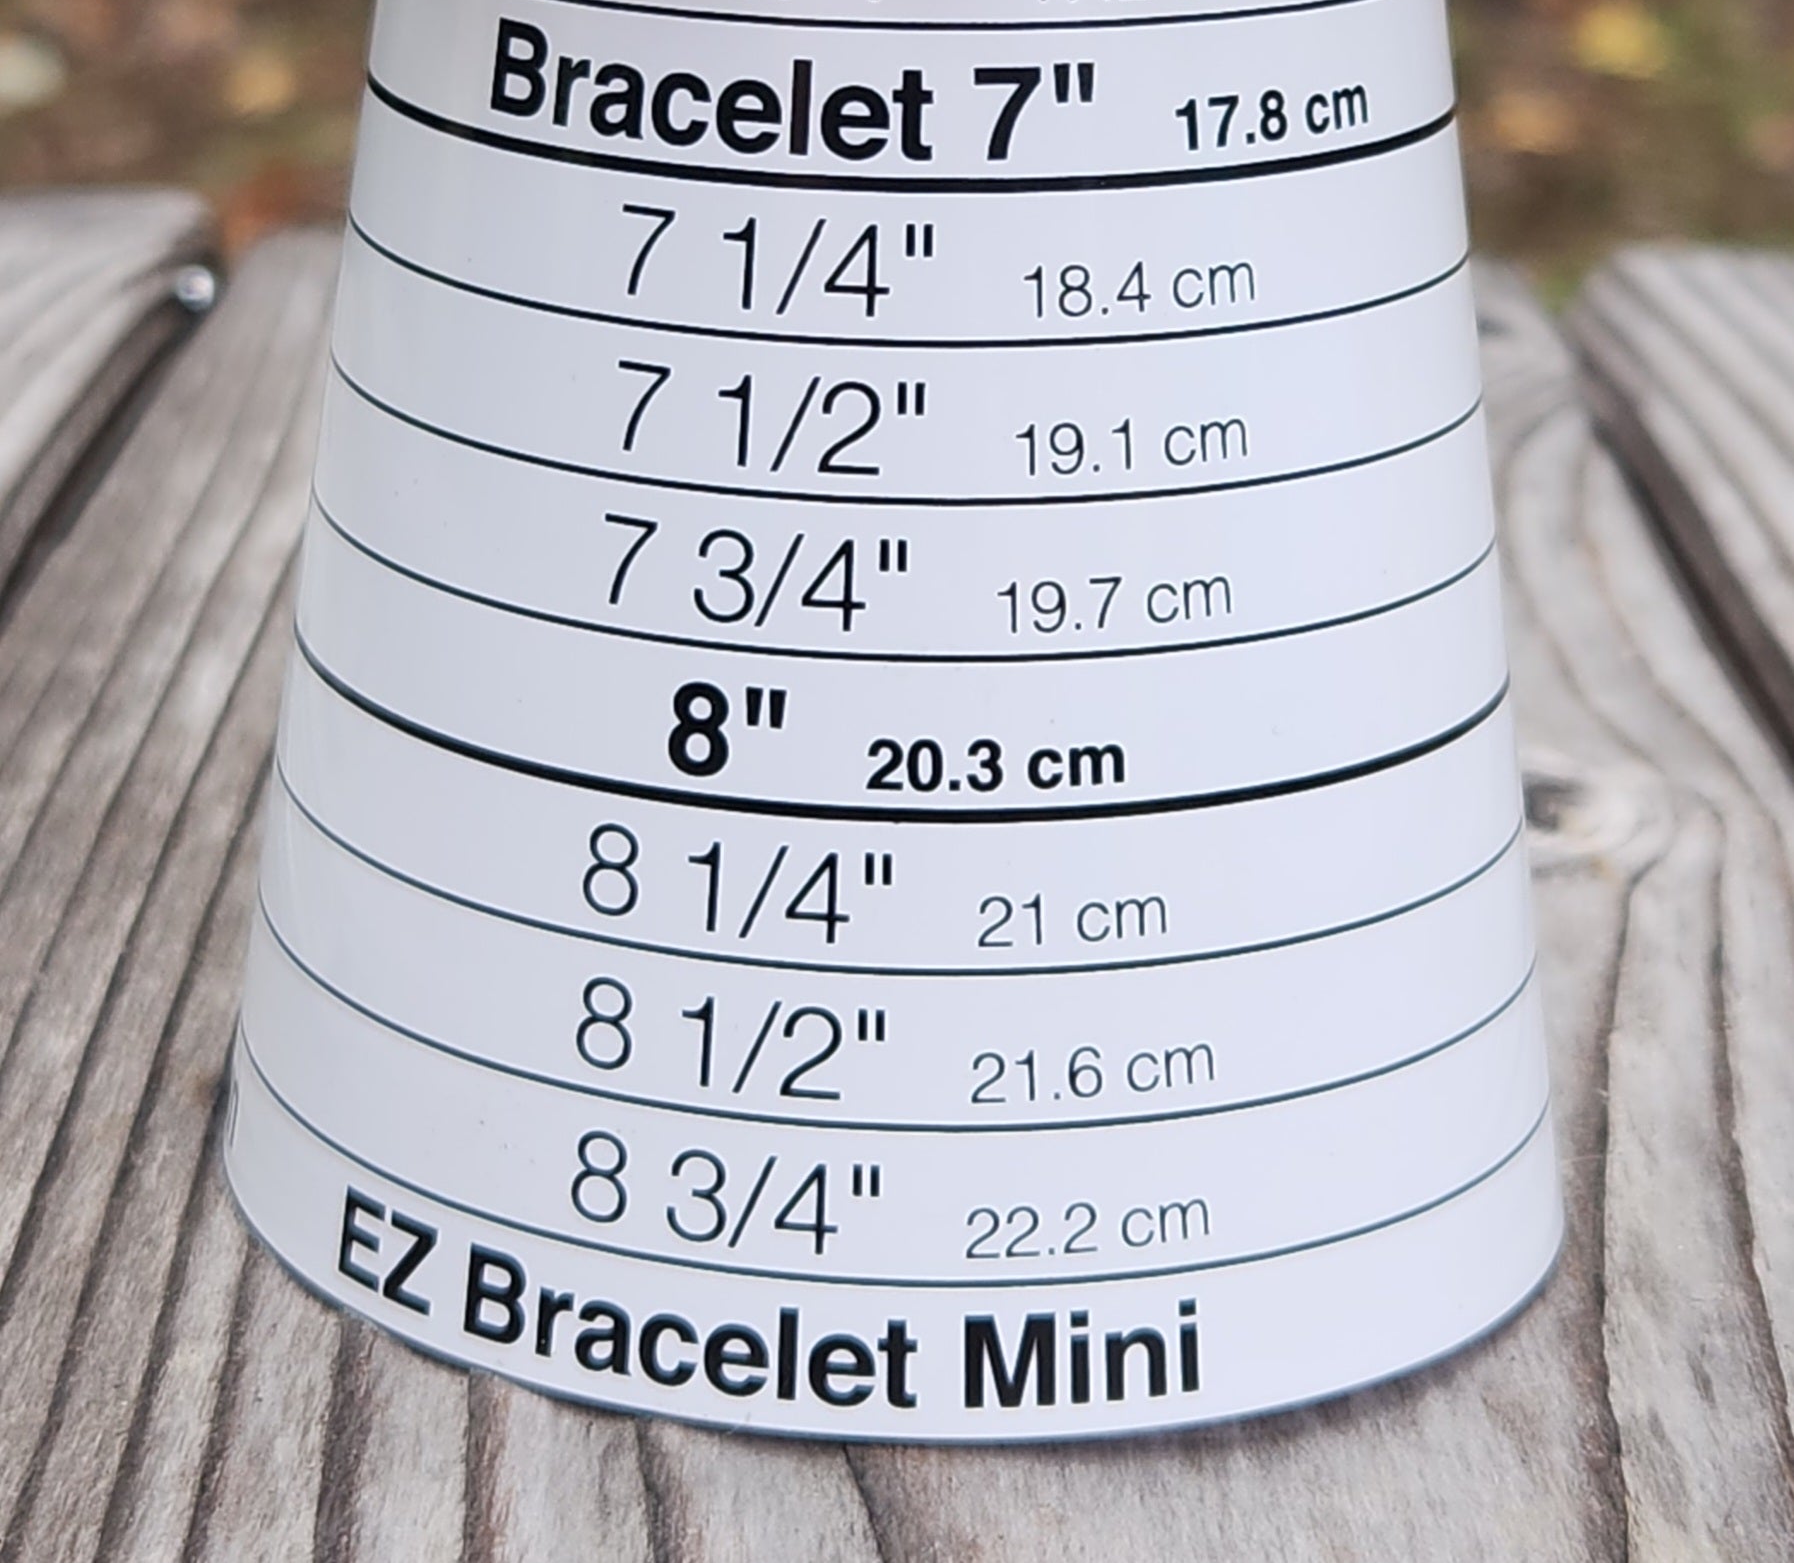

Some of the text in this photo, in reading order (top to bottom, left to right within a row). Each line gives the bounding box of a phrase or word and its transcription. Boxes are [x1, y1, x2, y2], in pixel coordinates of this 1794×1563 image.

[490, 18, 1369, 162] Bracelet 7" 17.8 cm
[622, 203, 1255, 319] 7 1/4" 18.4 cm
[618, 359, 1248, 477] 7 1/2" 19.1 cm
[604, 512, 1232, 634] 7 3/4" 19.7 cm
[667, 681, 1125, 793] 8" 20.3 cm
[582, 822, 1167, 948] 8 1/4" 21 cm
[575, 976, 1215, 1105] 8 1/2" 21.6 cm
[570, 1130, 1210, 1260] 8 3/4" 22.2 cm
[335, 1186, 1200, 1410] EZ Bracelet Mini
